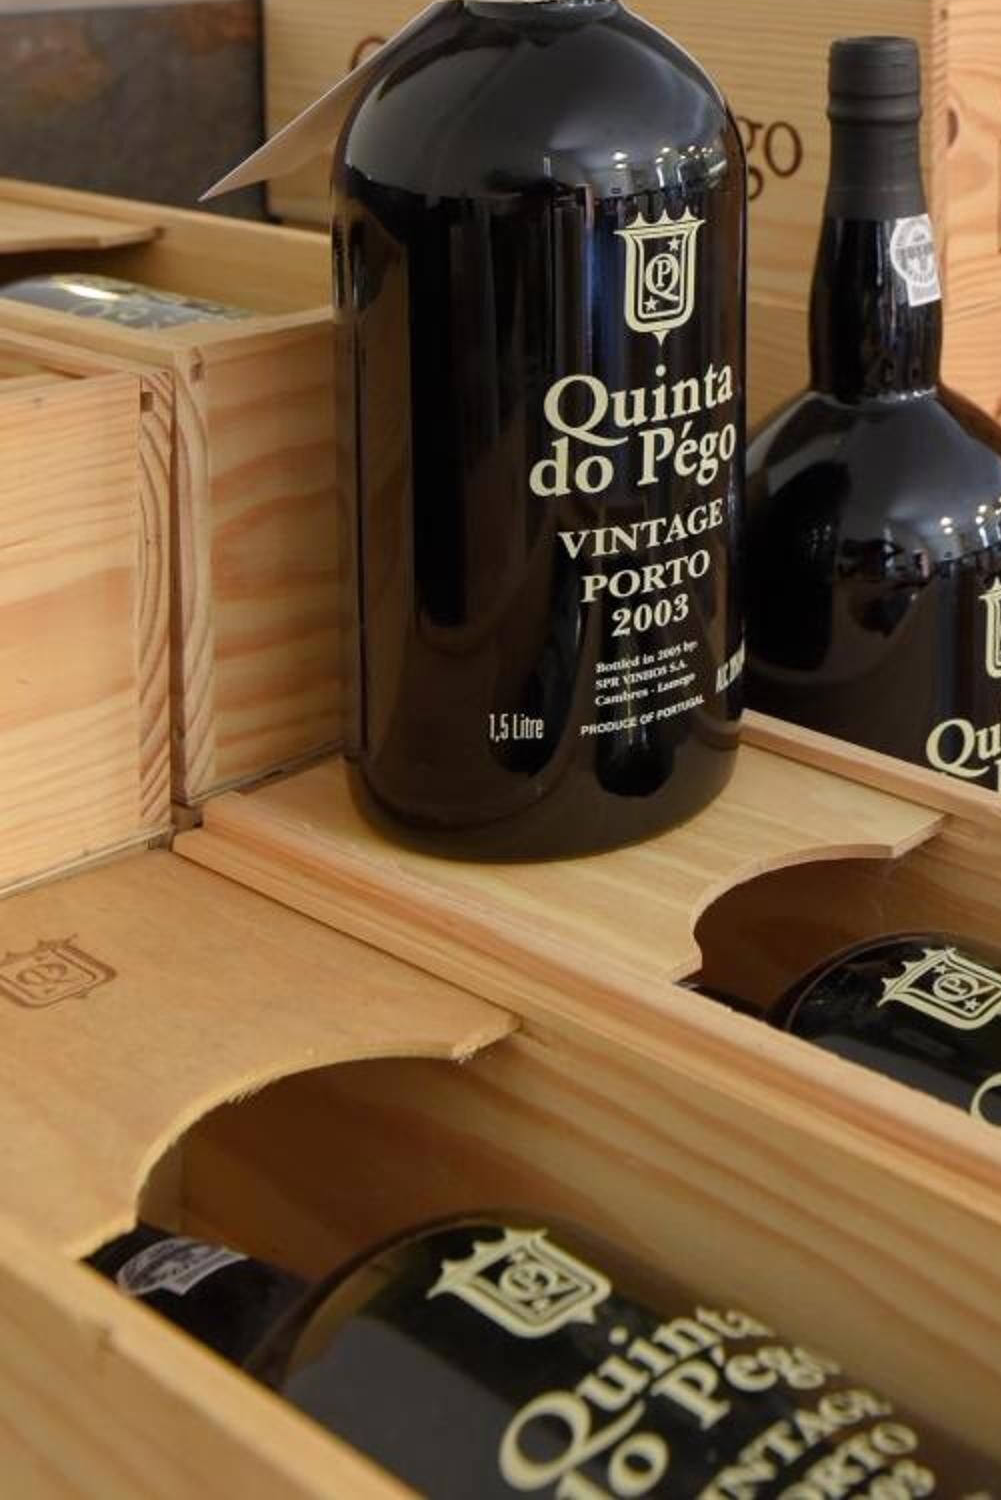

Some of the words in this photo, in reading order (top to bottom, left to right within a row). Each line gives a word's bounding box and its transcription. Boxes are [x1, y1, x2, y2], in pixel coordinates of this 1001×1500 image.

[543, 363, 734, 448] Quinta
[529, 436, 615, 498] do
[635, 420, 737, 487] Pégo
[557, 498, 724, 560] VINTAGE
[581, 549, 711, 603] PORTO
[611, 593, 690, 637] 2003
[580, 715, 638, 736] PRODUCE
[639, 711, 656, 726] OF
[656, 693, 705, 722] PORTUGAL
[594, 688, 649, 707] Cambres
[489, 713, 510, 743] 1,5
[513, 713, 544, 740] Litre
